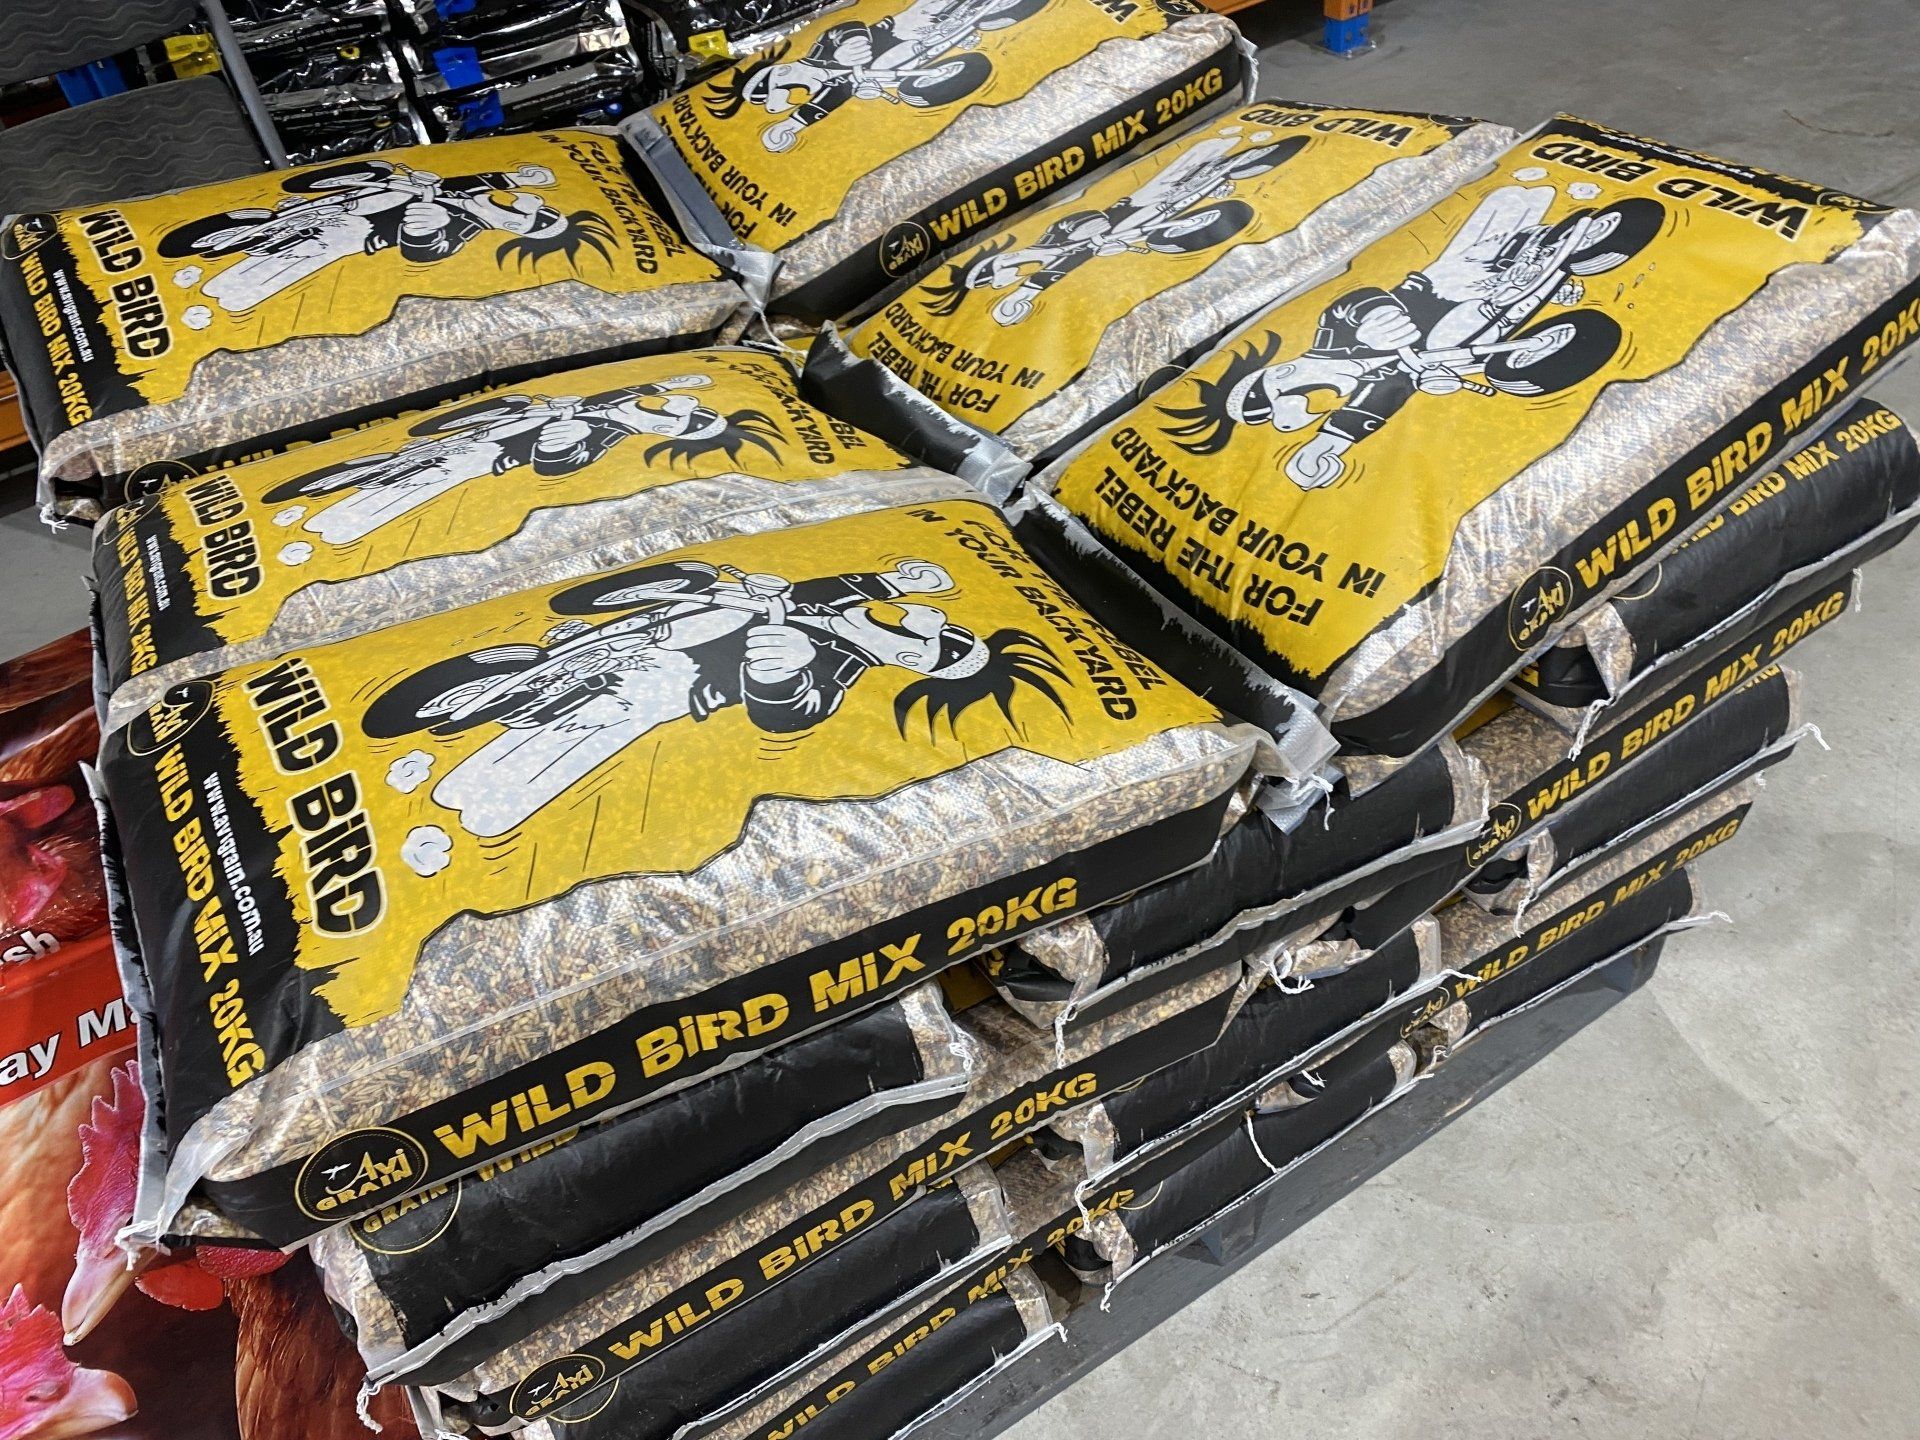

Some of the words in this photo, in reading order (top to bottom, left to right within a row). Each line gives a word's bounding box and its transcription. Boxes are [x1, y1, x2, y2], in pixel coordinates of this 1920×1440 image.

[672, 94, 727, 173] BACKYARD
[1237, 108, 1322, 128] BIRD
[1311, 117, 1416, 149] WILD
[721, 165, 768, 211] YOUR
[929, 187, 996, 241] WILD
[1014, 146, 1085, 200] BIRD
[1091, 109, 1149, 159] MIX
[1155, 68, 1223, 124] 20KG
[1529, 142, 1660, 183] BIRD
[78, 208, 145, 275] WILD
[600, 186, 658, 274] BACKYARD
[768, 202, 797, 227] IN
[1655, 178, 1815, 242] WILD
[110, 273, 174, 360] BIRD
[885, 302, 954, 363] BACKYARD
[58, 372, 93, 426] 20KG
[948, 382, 1000, 413] FOR
[950, 349, 1009, 383] YOUR
[1011, 367, 1045, 389] IN
[1574, 497, 1677, 589] WILD
[1685, 422, 1773, 511] BIRD
[1781, 355, 1850, 435] MIX
[1861, 298, 1920, 375] 20K
[1784, 440, 1839, 481] MIX
[1836, 409, 1902, 454] 20KG
[182, 473, 248, 527] WILD
[1094, 465, 1176, 553] REBEL
[1111, 427, 1239, 536] BACKYARD
[202, 519, 265, 600] BIRD
[1177, 536, 1236, 594] THE
[1237, 520, 1329, 582] YOUR
[1337, 562, 1387, 599] IN
[944, 528, 1023, 579] YOUR
[1013, 585, 1138, 721] BACKYARD
[1242, 573, 1324, 627] FOR
[241, 656, 345, 776] WILD
[1528, 751, 1610, 820] WILD
[1620, 694, 1696, 760] BIRD
[1703, 644, 1762, 705] MIX
[1769, 591, 1845, 657] 20KG
[155, 742, 193, 821] WILD
[172, 817, 214, 901] BIRD
[203, 771, 265, 957] www.avigrain.com.au
[285, 769, 388, 939] BIRD
[1537, 900, 1606, 951] BIRD
[1613, 861, 1667, 907] MIX
[1674, 819, 1740, 869] 20KG
[0, 930, 61, 967] sh
[194, 895, 239, 983] MIX
[77, 998, 140, 1048] M
[209, 978, 267, 1089] 20KG
[433, 1059, 616, 1160] WILD
[635, 992, 790, 1079] BIRD
[808, 932, 925, 1014] MIX
[946, 876, 1079, 957] 20KG
[607, 1278, 744, 1360] WILD
[758, 1199, 875, 1281] BIRD
[889, 1131, 974, 1200] MIX
[990, 1072, 1097, 1140] 20KG
[867, 1307, 956, 1376] BIRD
